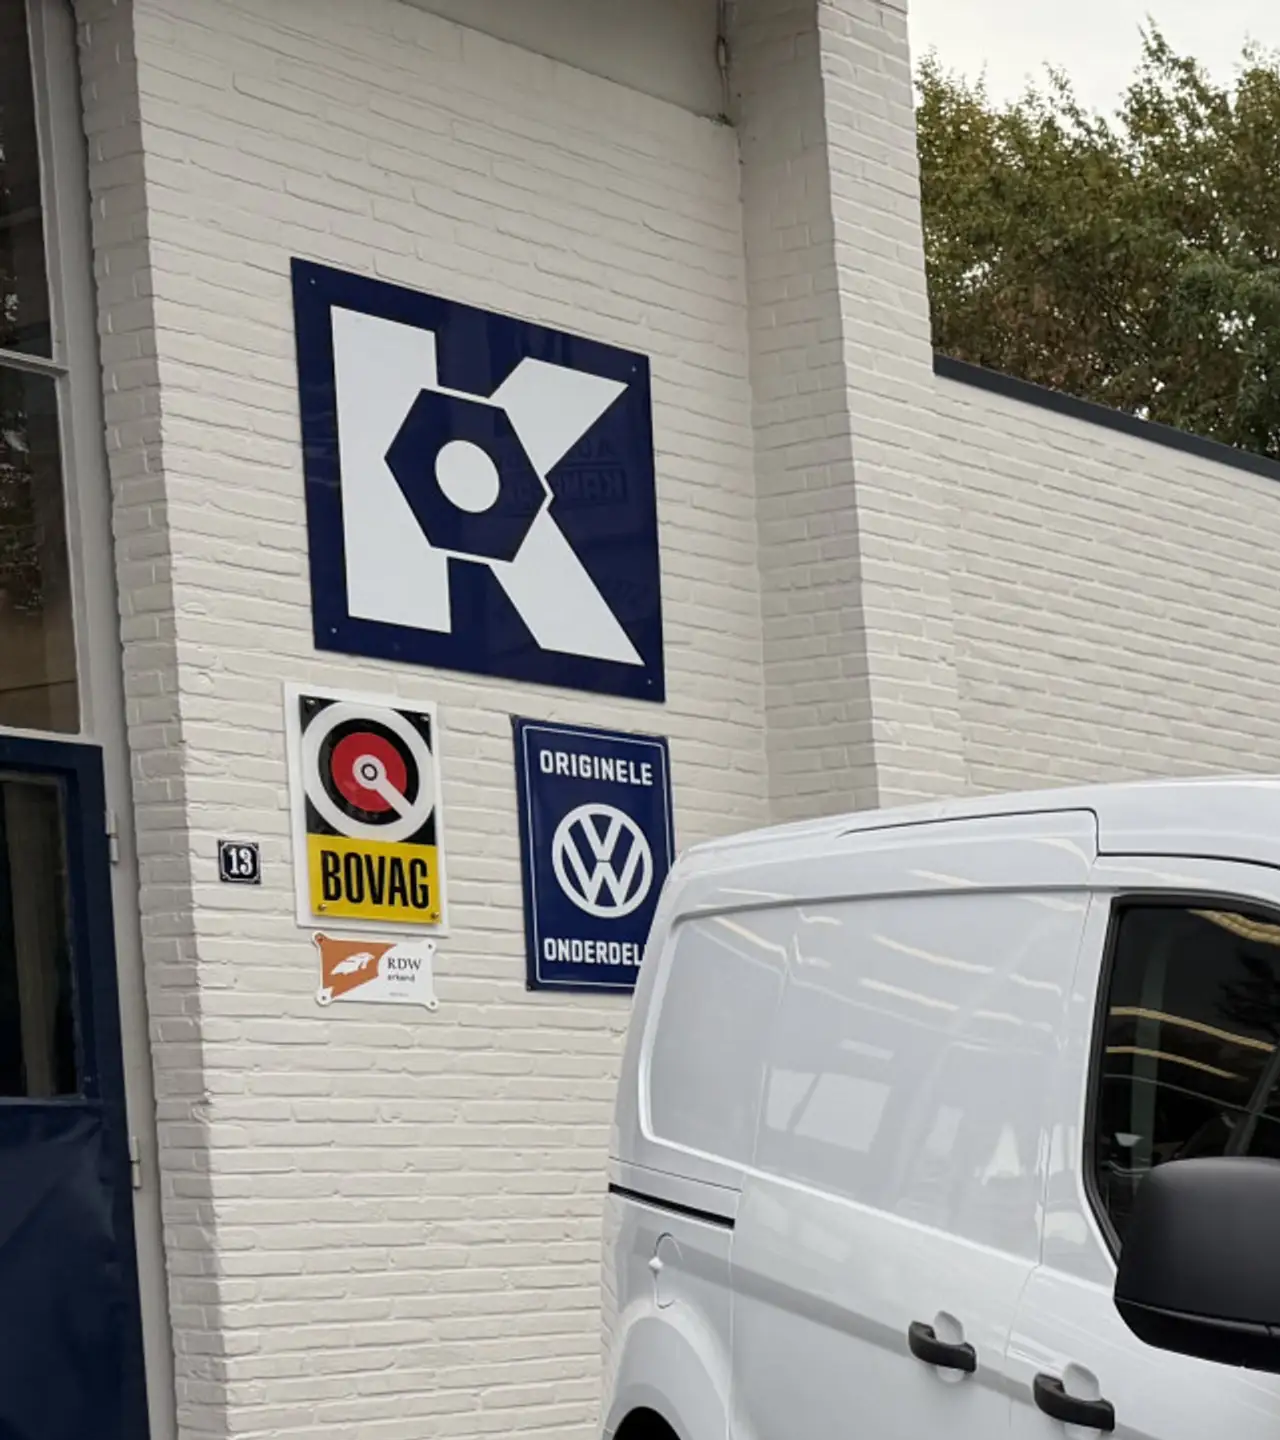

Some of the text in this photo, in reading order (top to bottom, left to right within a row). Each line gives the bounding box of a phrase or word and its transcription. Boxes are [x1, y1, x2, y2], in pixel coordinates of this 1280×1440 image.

[540, 750, 653, 786] ORIGINELE
[229, 847, 254, 876] 13
[320, 849, 430, 910] BOVAG
[387, 957, 422, 970] RDW
[544, 937, 646, 966] ONDERDEL
